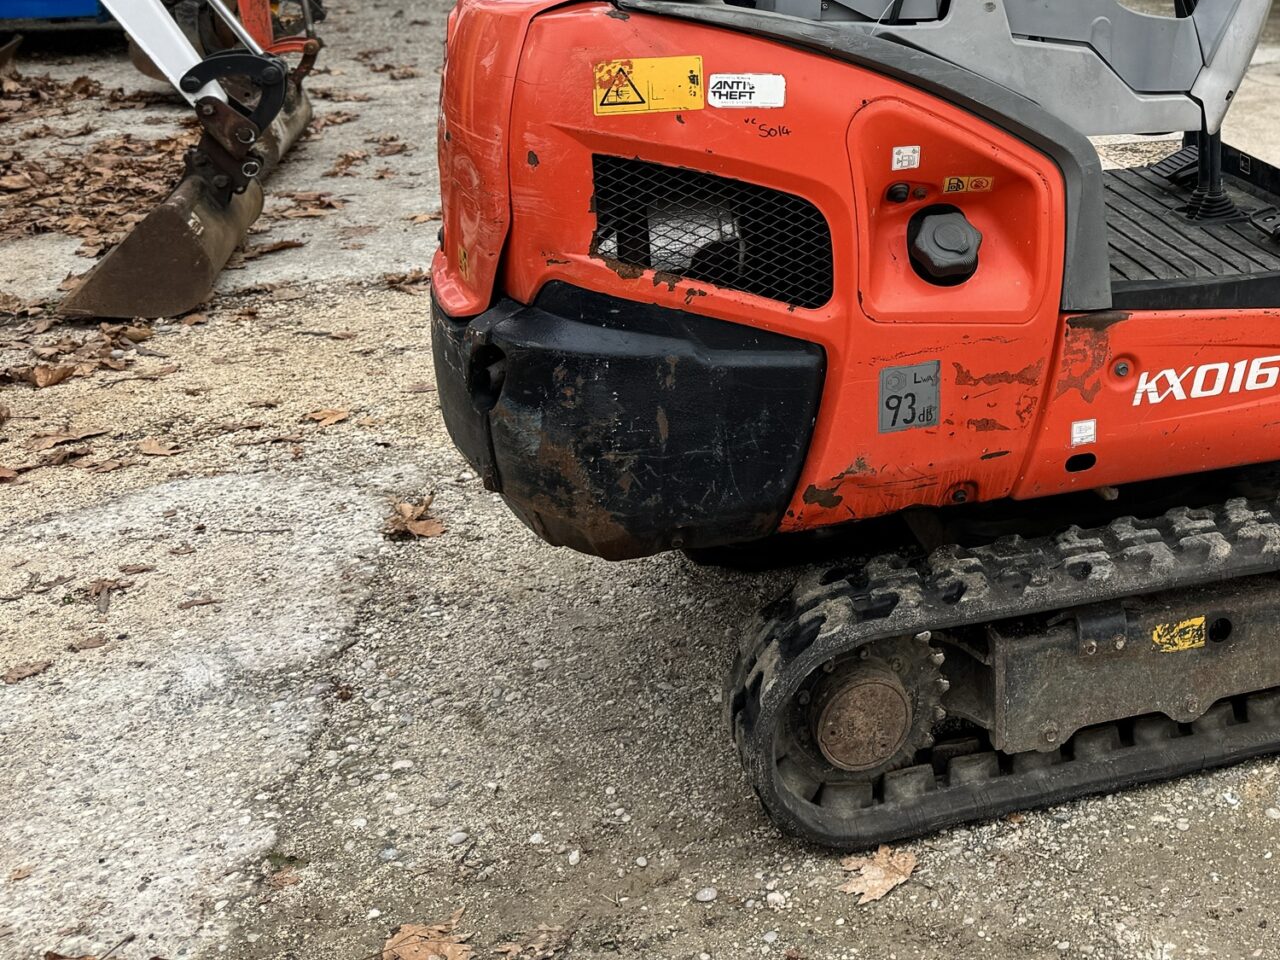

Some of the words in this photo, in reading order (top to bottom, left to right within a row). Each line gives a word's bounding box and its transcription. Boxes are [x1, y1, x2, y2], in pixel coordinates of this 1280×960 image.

[711, 91, 756, 100] THEFT
[885, 392, 916, 427] 93
[918, 407, 933, 422] dB
